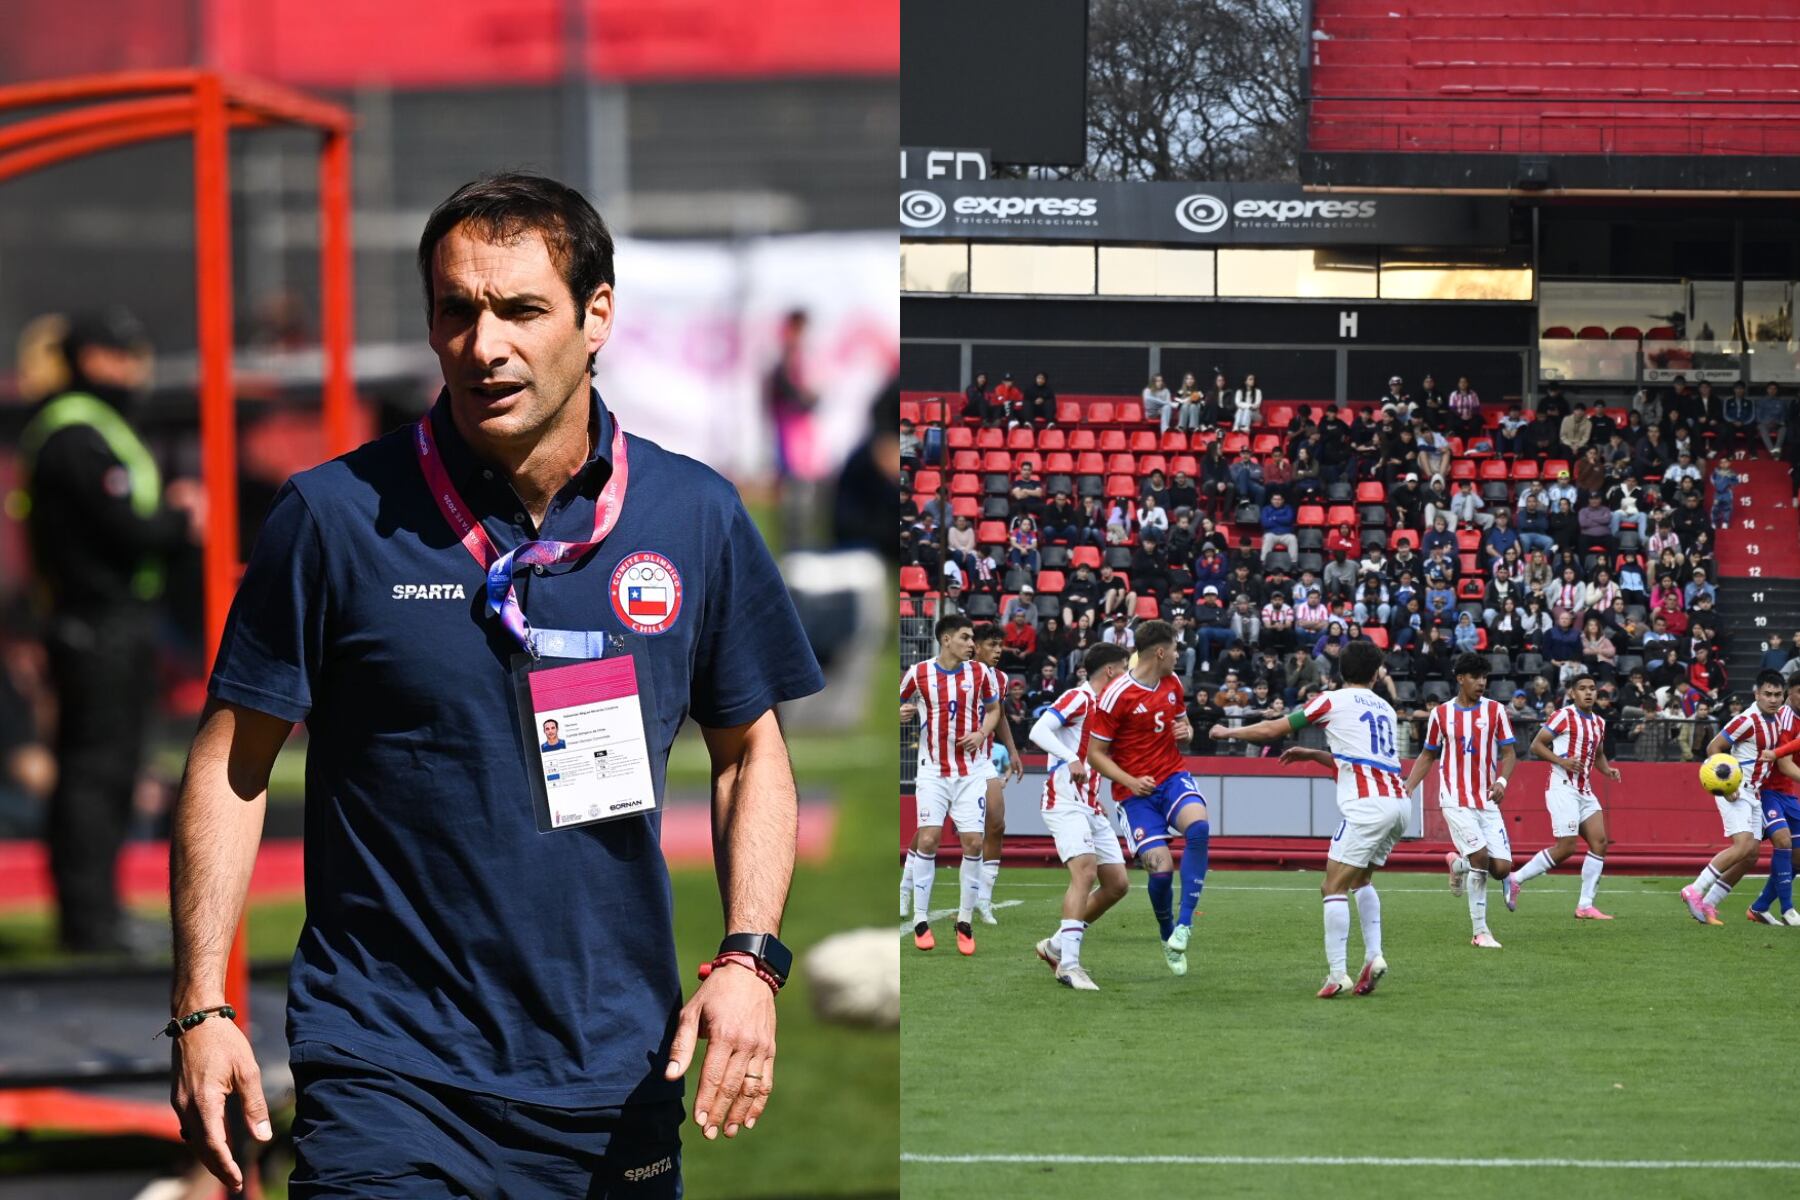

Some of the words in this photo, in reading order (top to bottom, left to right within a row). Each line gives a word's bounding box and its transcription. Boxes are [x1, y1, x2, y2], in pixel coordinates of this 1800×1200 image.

[953, 196, 1097, 218] express
[1232, 199, 1377, 221] express
[955, 217, 1099, 226] Telecomunicaciones
[1234, 220, 1378, 229] Telecomunicaciones
[1340, 311, 1358, 338] H
[1735, 450, 1746, 460] 17
[1738, 473, 1749, 483] 16
[1740, 497, 1752, 507] 15
[1743, 520, 1755, 529] 14
[1746, 544, 1759, 555] 13
[612, 555, 640, 585] COMITE
[643, 554, 680, 587] OLIMPICO
[1748, 567, 1761, 578] 12
[391, 583, 466, 600] SPARTA
[1752, 591, 1764, 602] 11
[1754, 616, 1767, 627] 10
[631, 623, 666, 633] CHILE
[1761, 641, 1769, 652] 9
[947, 700, 958, 721] 9
[1154, 711, 1165, 733] 5
[1359, 710, 1395, 758] 10
[1461, 735, 1476, 755] 14
[624, 1156, 672, 1181] SPARTA
